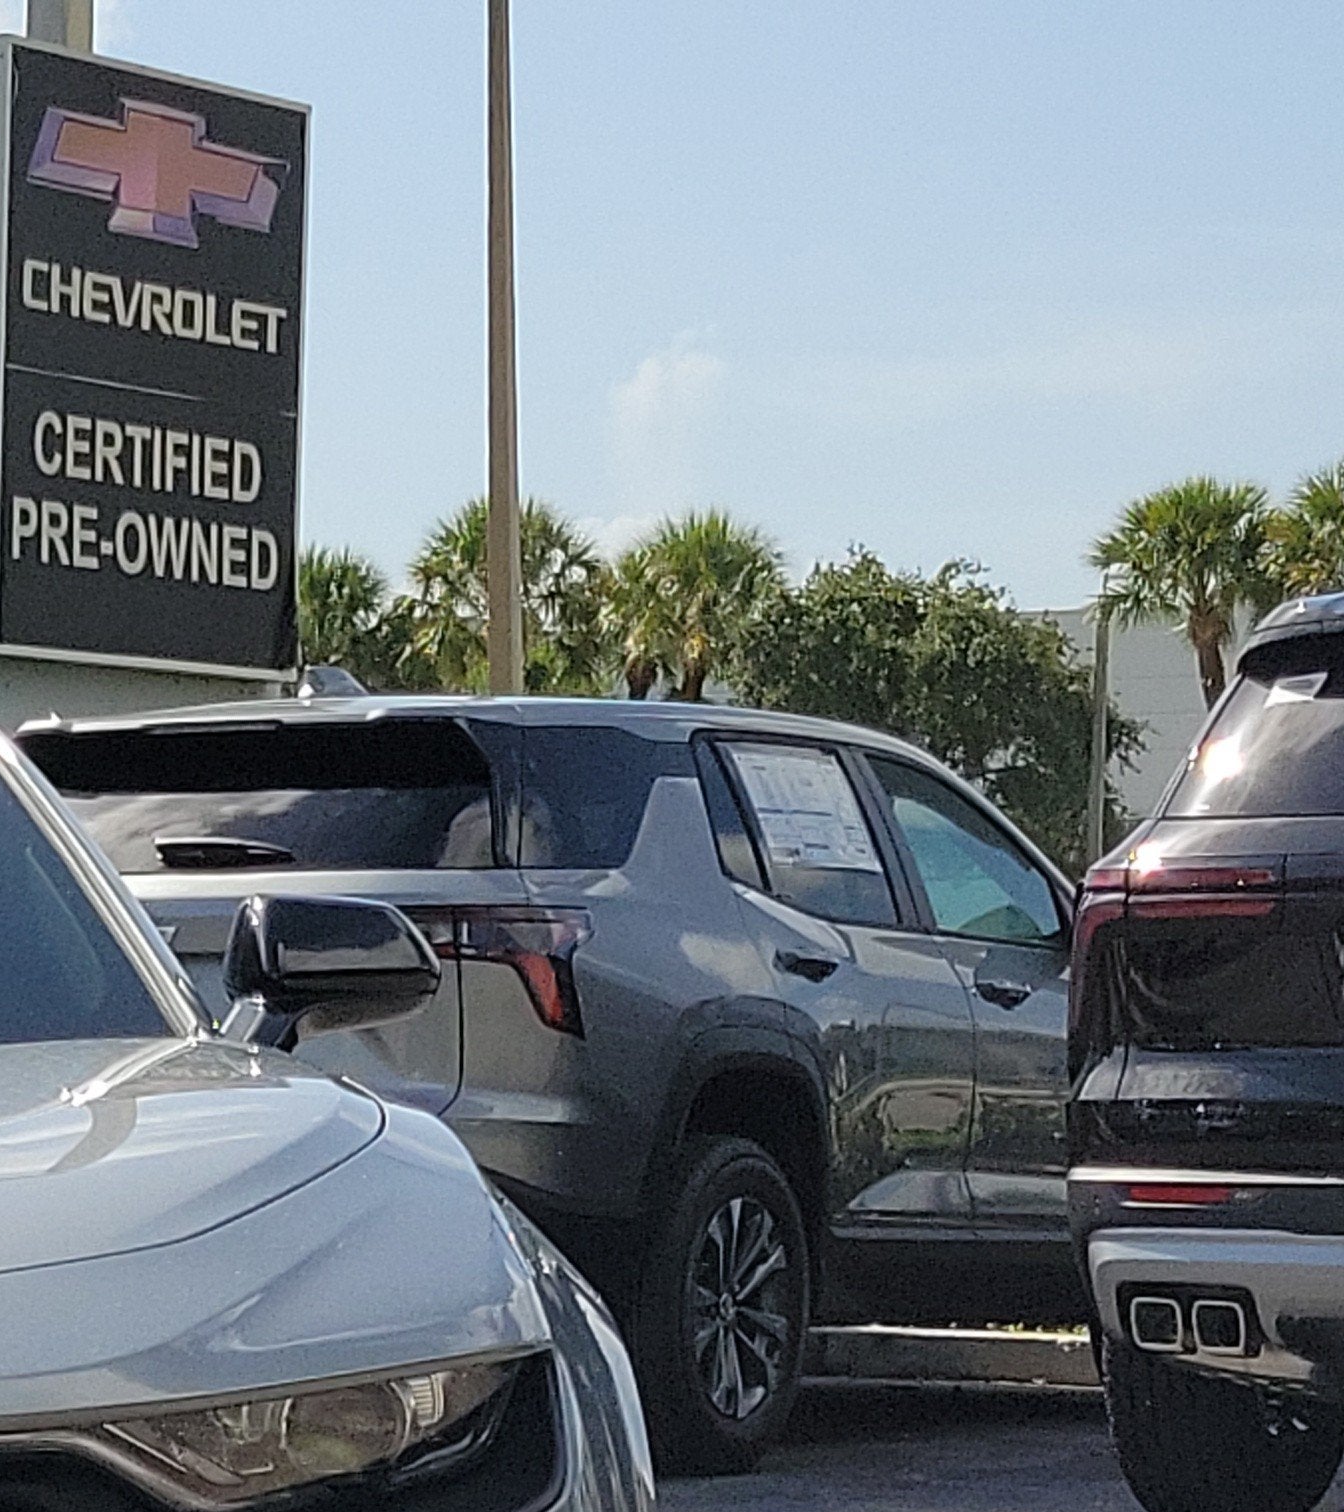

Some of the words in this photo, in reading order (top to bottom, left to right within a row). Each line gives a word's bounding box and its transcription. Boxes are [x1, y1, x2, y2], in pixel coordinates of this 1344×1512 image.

[22, 258, 288, 354] CHEVROLET
[33, 410, 262, 503] CERTIFIED
[11, 495, 279, 591] PRE-OWNED
